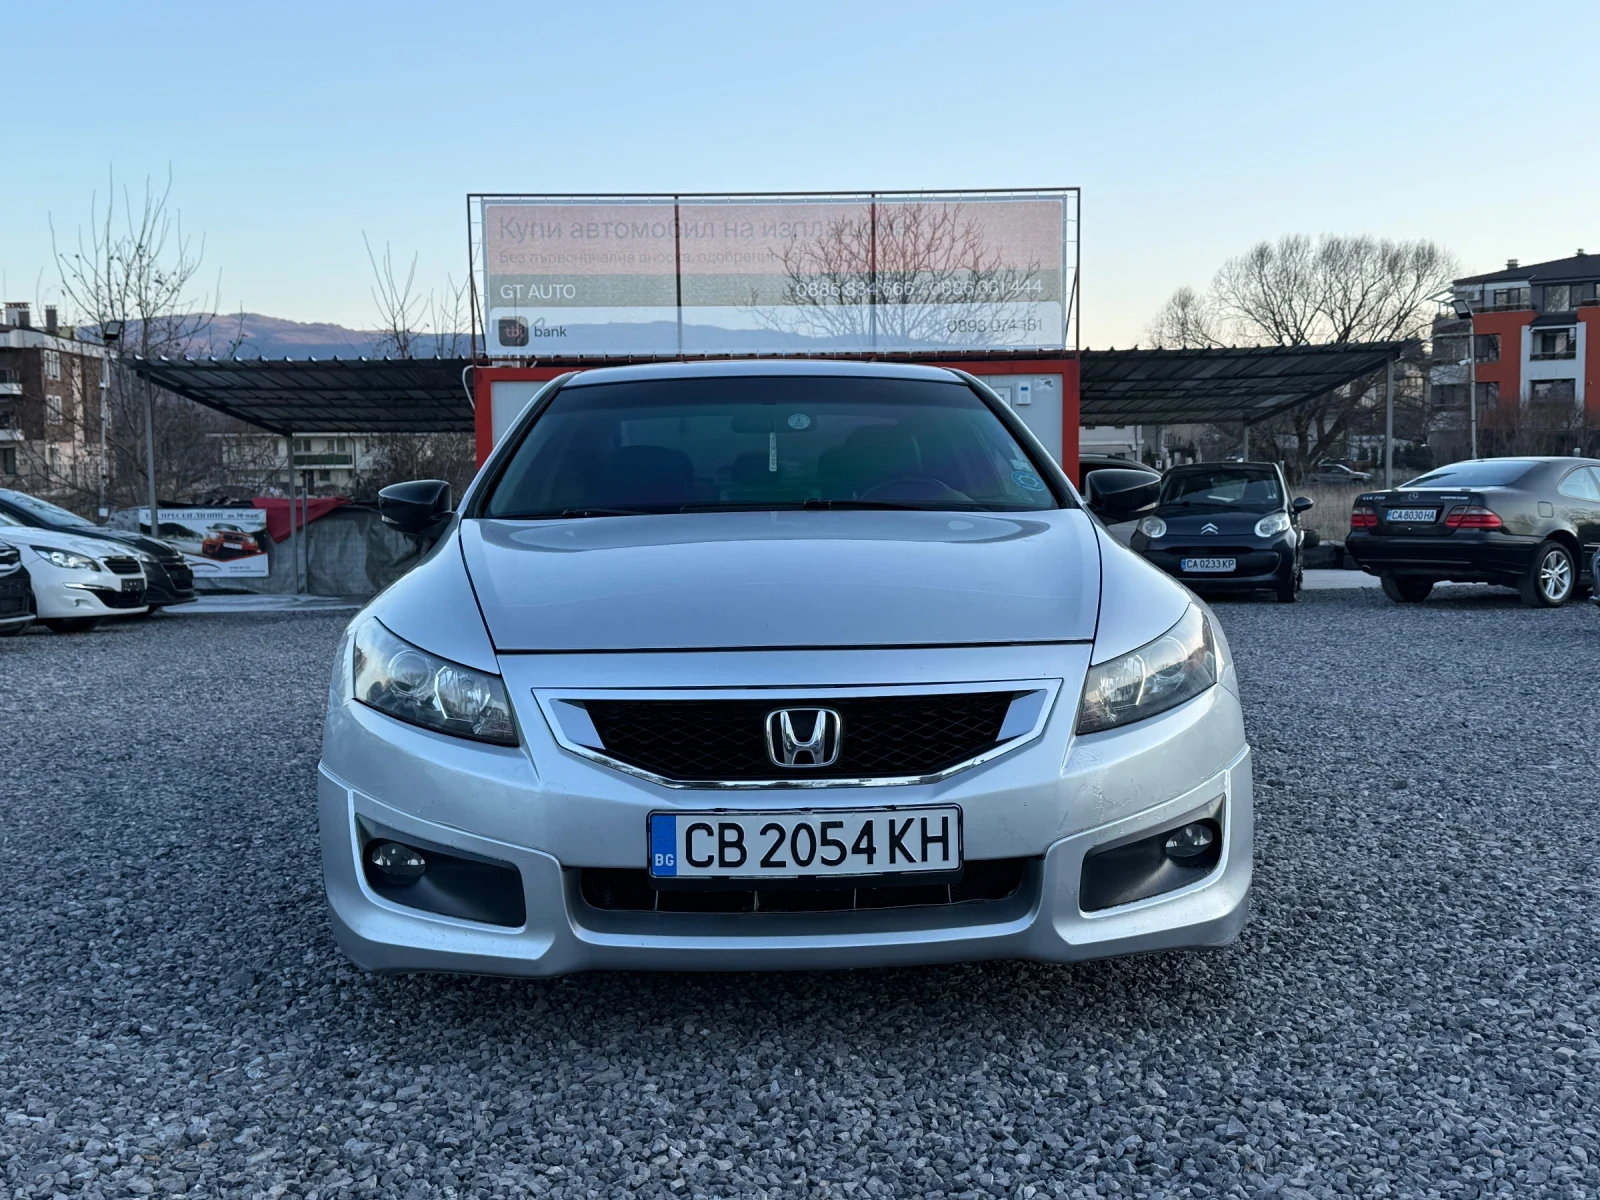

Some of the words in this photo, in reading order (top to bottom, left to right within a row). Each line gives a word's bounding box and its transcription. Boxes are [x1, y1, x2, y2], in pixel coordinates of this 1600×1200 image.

[500, 216, 562, 243] Купи
[570, 217, 715, 239] автомобил
[724, 220, 755, 239] на
[499, 250, 526, 264] Без
[529, 251, 635, 266] първоначална
[639, 251, 694, 266] вноса,
[500, 284, 524, 299] GT
[528, 284, 576, 299] AUTO
[796, 282, 841, 297] 0886
[882, 281, 915, 296] 666
[929, 280, 974, 296] 0886
[1010, 279, 1044, 294] 444
[534, 325, 567, 338] bank
[947, 319, 987, 333] 0893
[1391, 510, 1403, 520] CA
[1403, 510, 1424, 520] 8030
[1424, 510, 1435, 520] HA
[1186, 559, 1199, 569] CA
[1199, 559, 1221, 569] 0233
[1222, 559, 1235, 569] KP
[654, 853, 674, 867] BG
[685, 822, 748, 868] CB
[759, 819, 877, 867] 2054
[888, 816, 950, 864] KH
